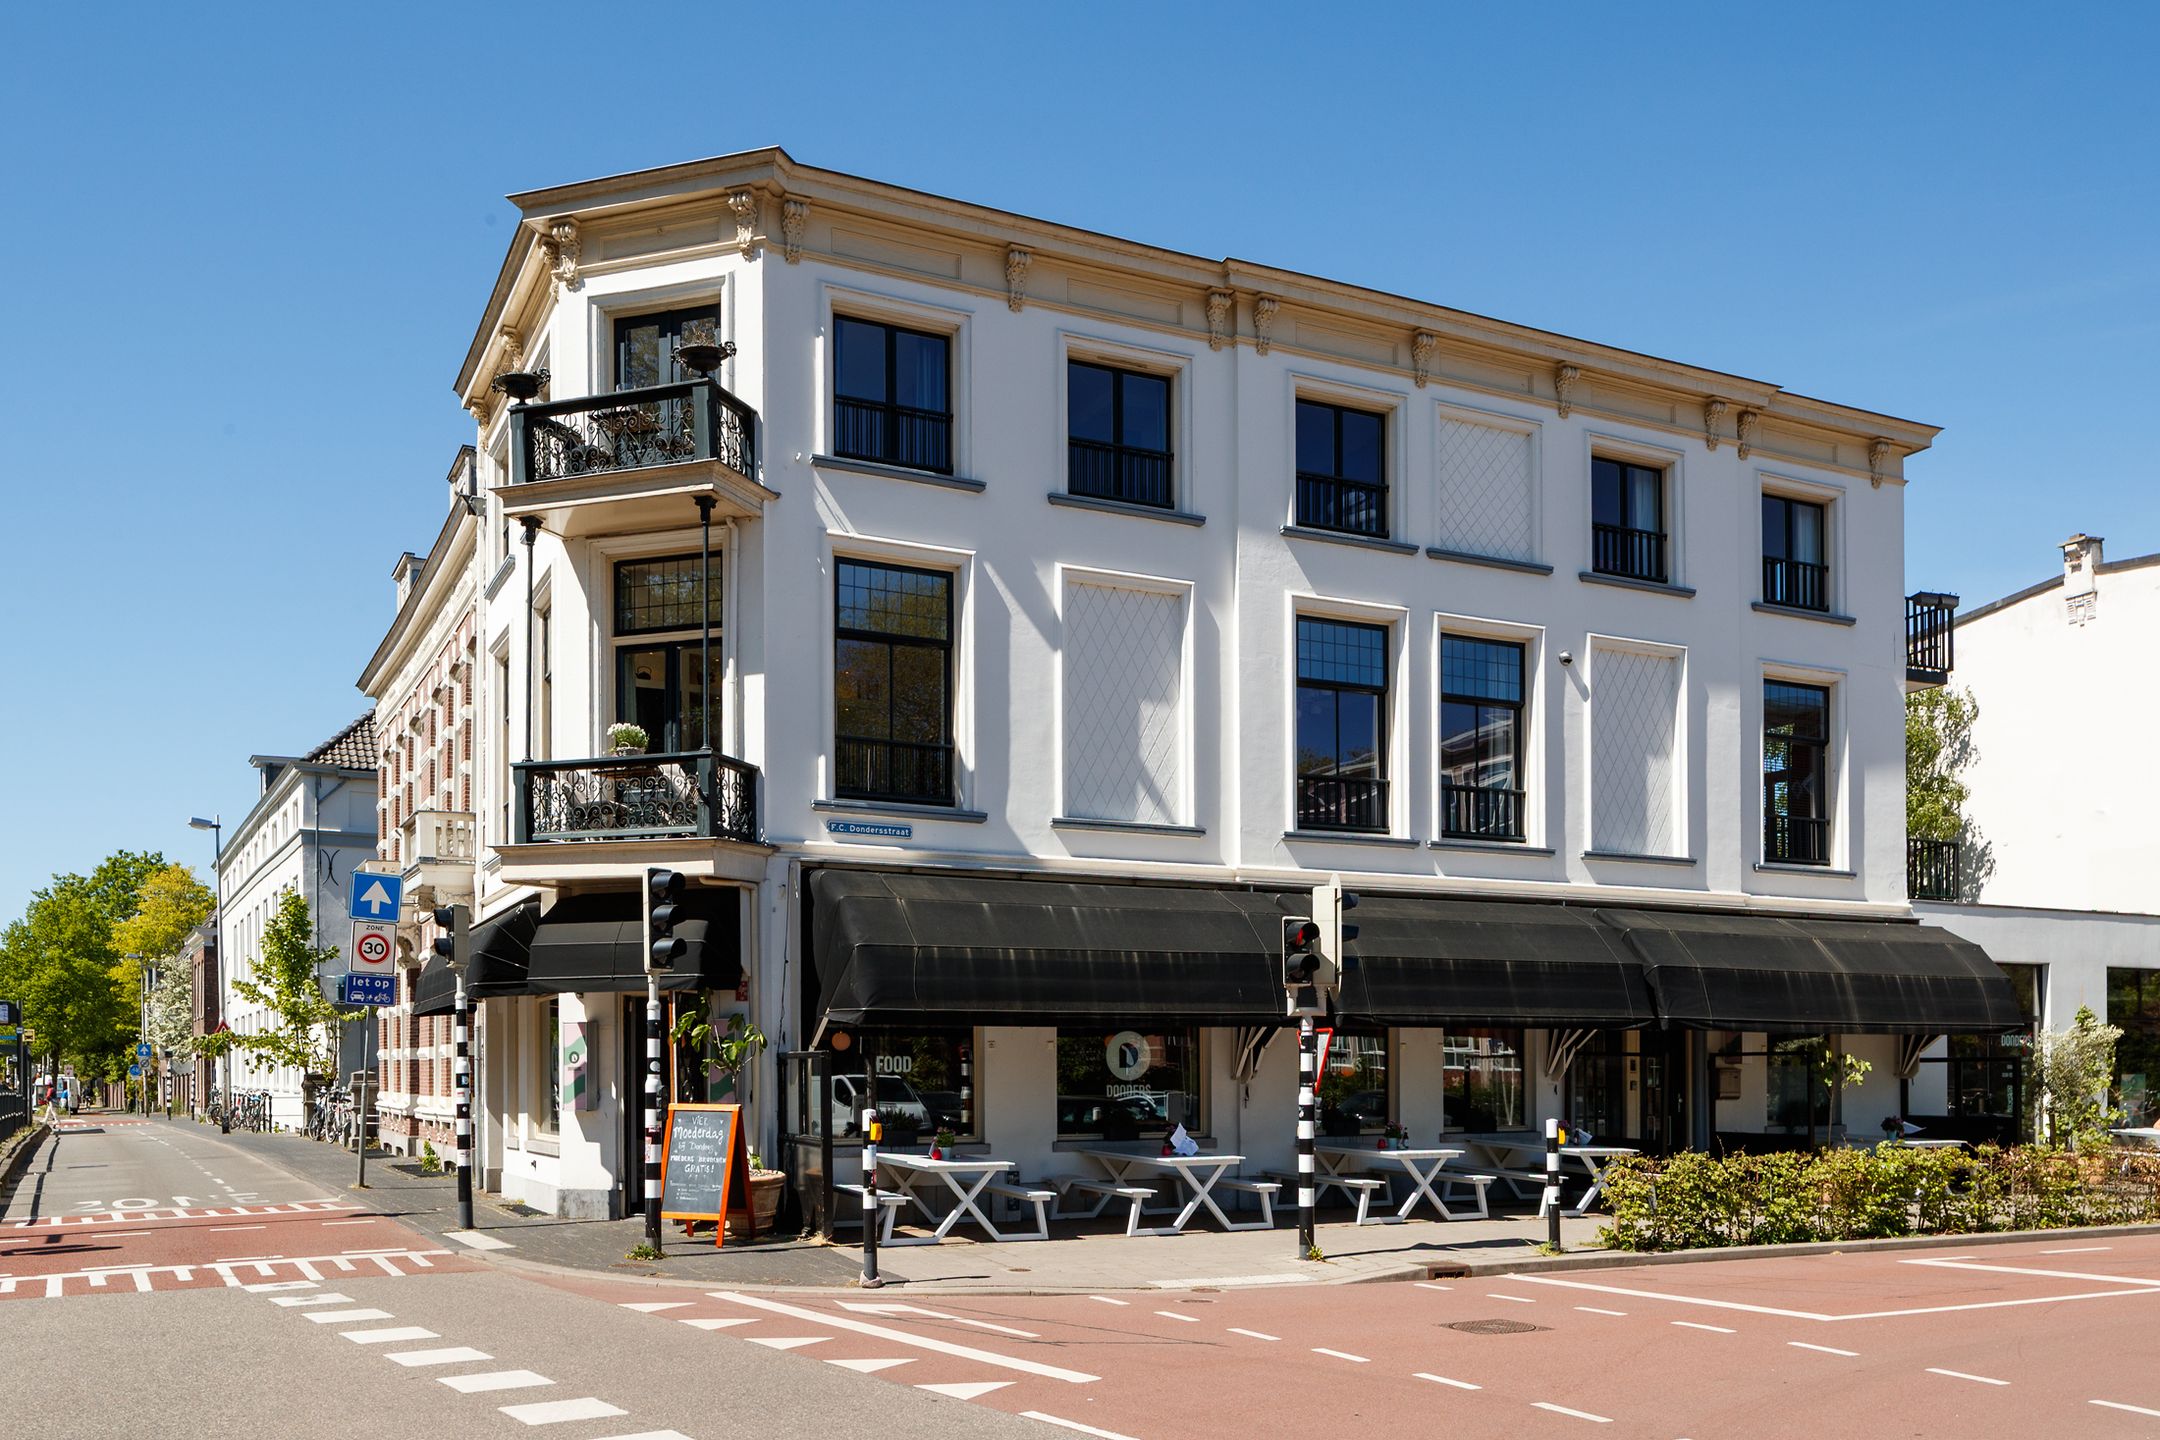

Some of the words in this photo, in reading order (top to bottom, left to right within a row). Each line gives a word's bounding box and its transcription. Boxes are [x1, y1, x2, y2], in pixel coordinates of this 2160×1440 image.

[831, 823, 847, 832] F.C.
[849, 825, 909, 836] Dondersstraat
[363, 942, 384, 955] 30
[353, 976, 370, 987] let
[374, 980, 390, 989] op
[876, 1055, 912, 1073] FOOD
[673, 1125, 724, 1145] Moederdag
